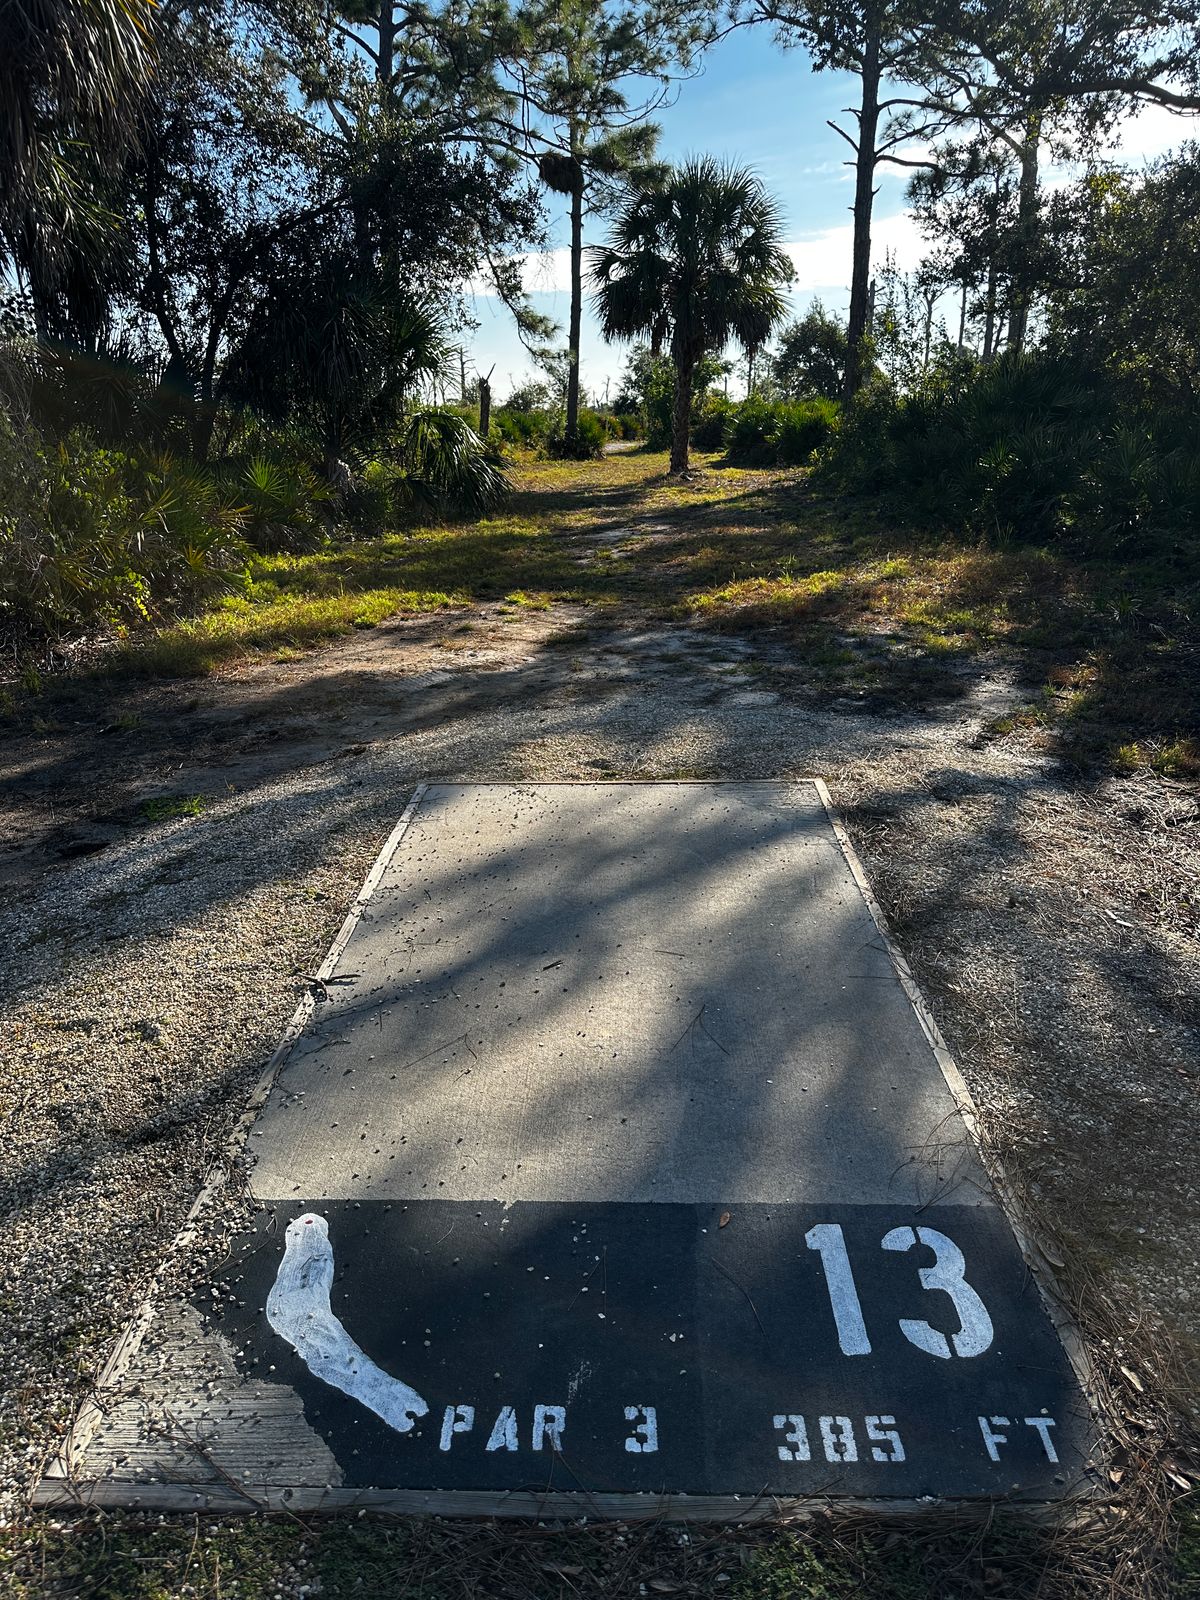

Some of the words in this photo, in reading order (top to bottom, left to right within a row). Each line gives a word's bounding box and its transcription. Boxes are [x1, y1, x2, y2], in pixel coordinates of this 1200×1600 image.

[804, 1222, 994, 1360] 13
[439, 1404, 566, 1452] PAR
[624, 1404, 659, 1453] 3
[772, 1413, 906, 1463] 385
[978, 1415, 1060, 1463] FT
